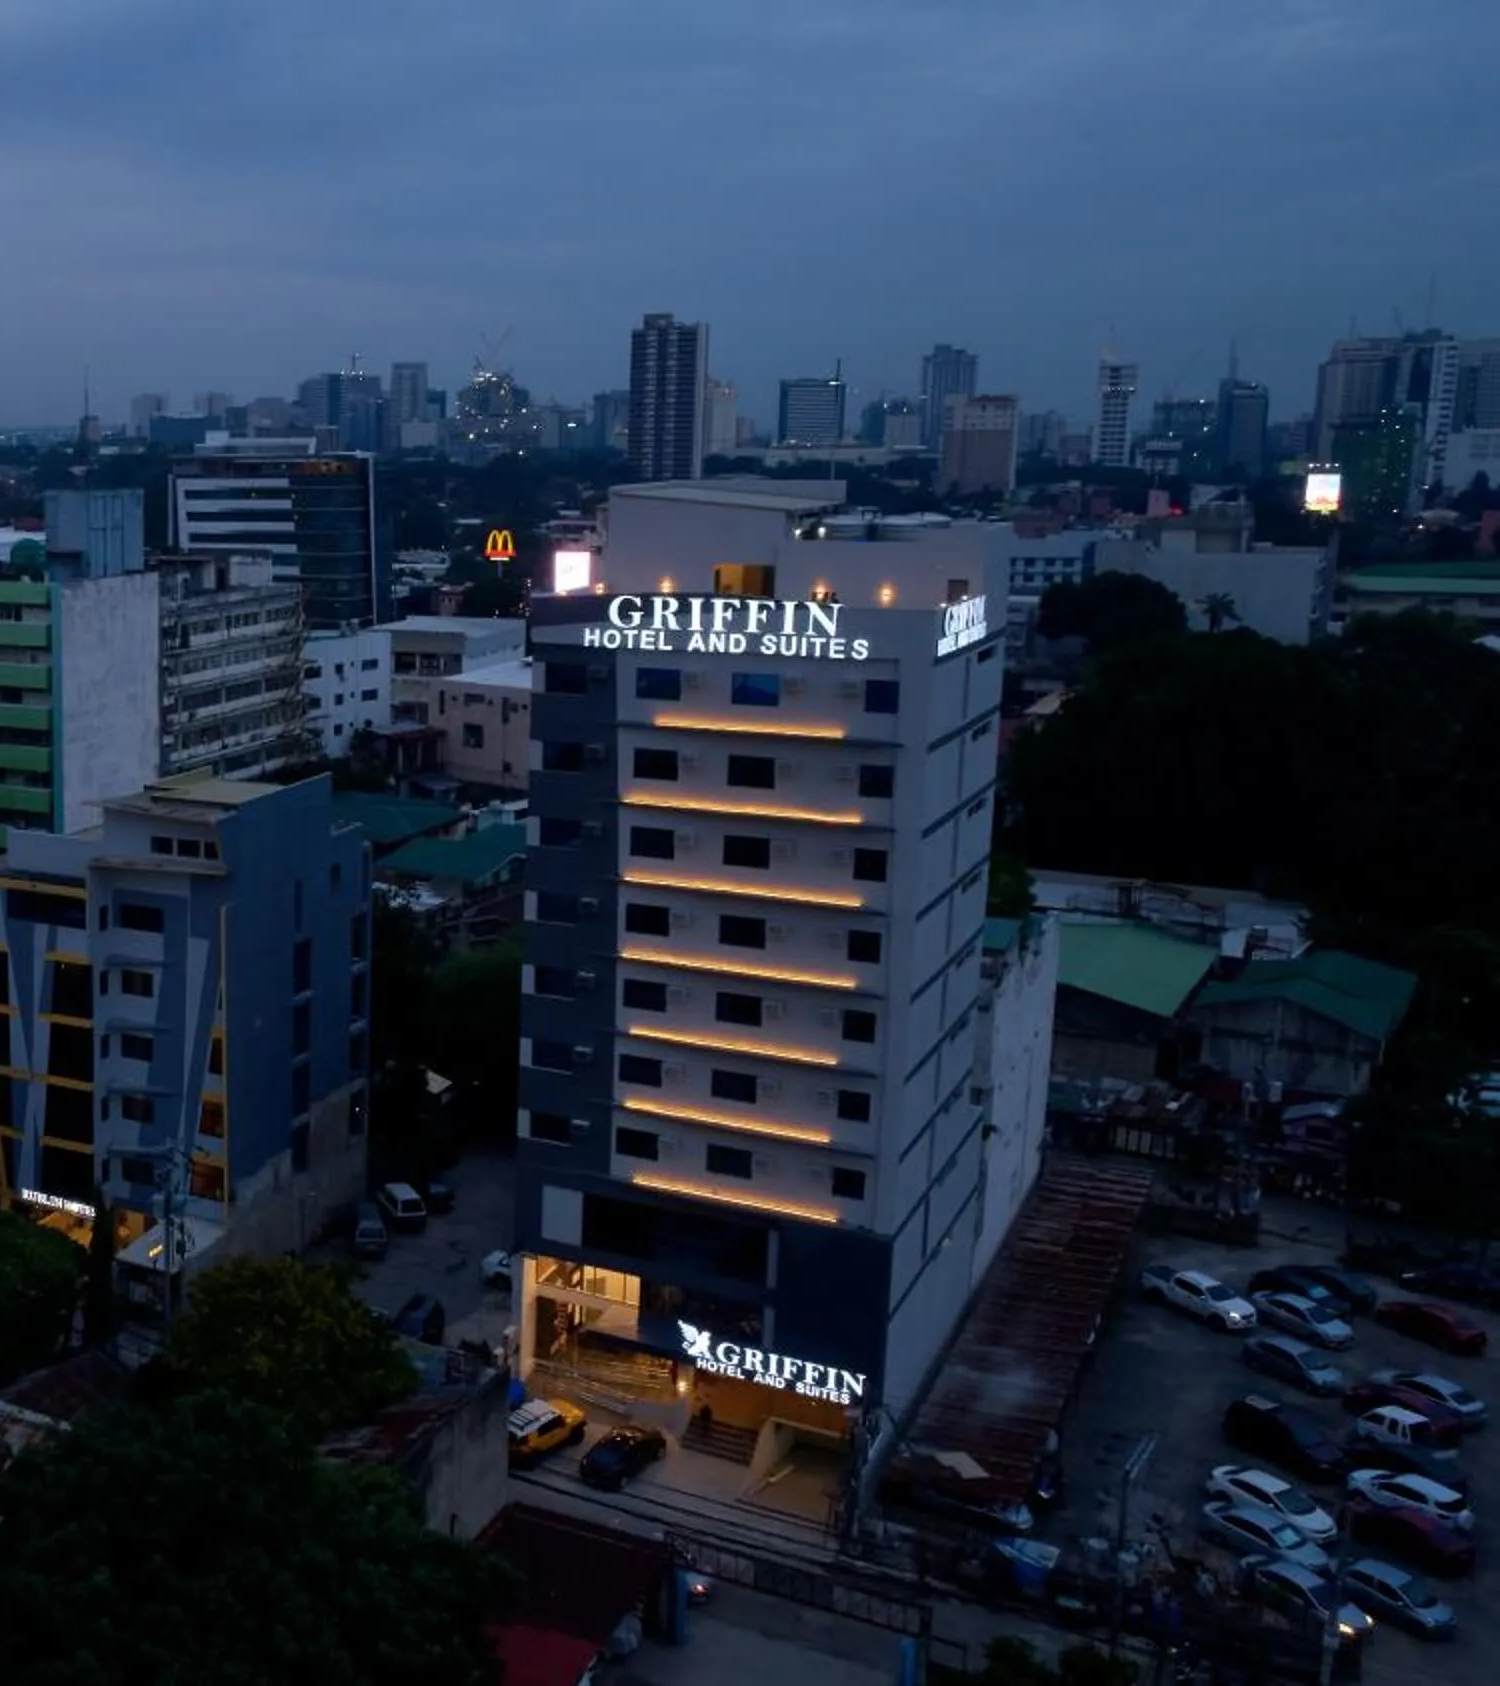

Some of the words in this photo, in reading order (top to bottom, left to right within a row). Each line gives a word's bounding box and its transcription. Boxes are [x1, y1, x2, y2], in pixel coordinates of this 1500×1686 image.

[607, 594, 845, 637] GRIFFIN
[583, 627, 673, 652] HOTEL
[687, 633, 747, 654] AND
[760, 634, 869, 661] SUITES
[696, 1357, 746, 1380] HOTEL
[752, 1371, 785, 1390] AND
[794, 1381, 851, 1406] SUITES
[715, 1341, 867, 1397] GRIFFIN
